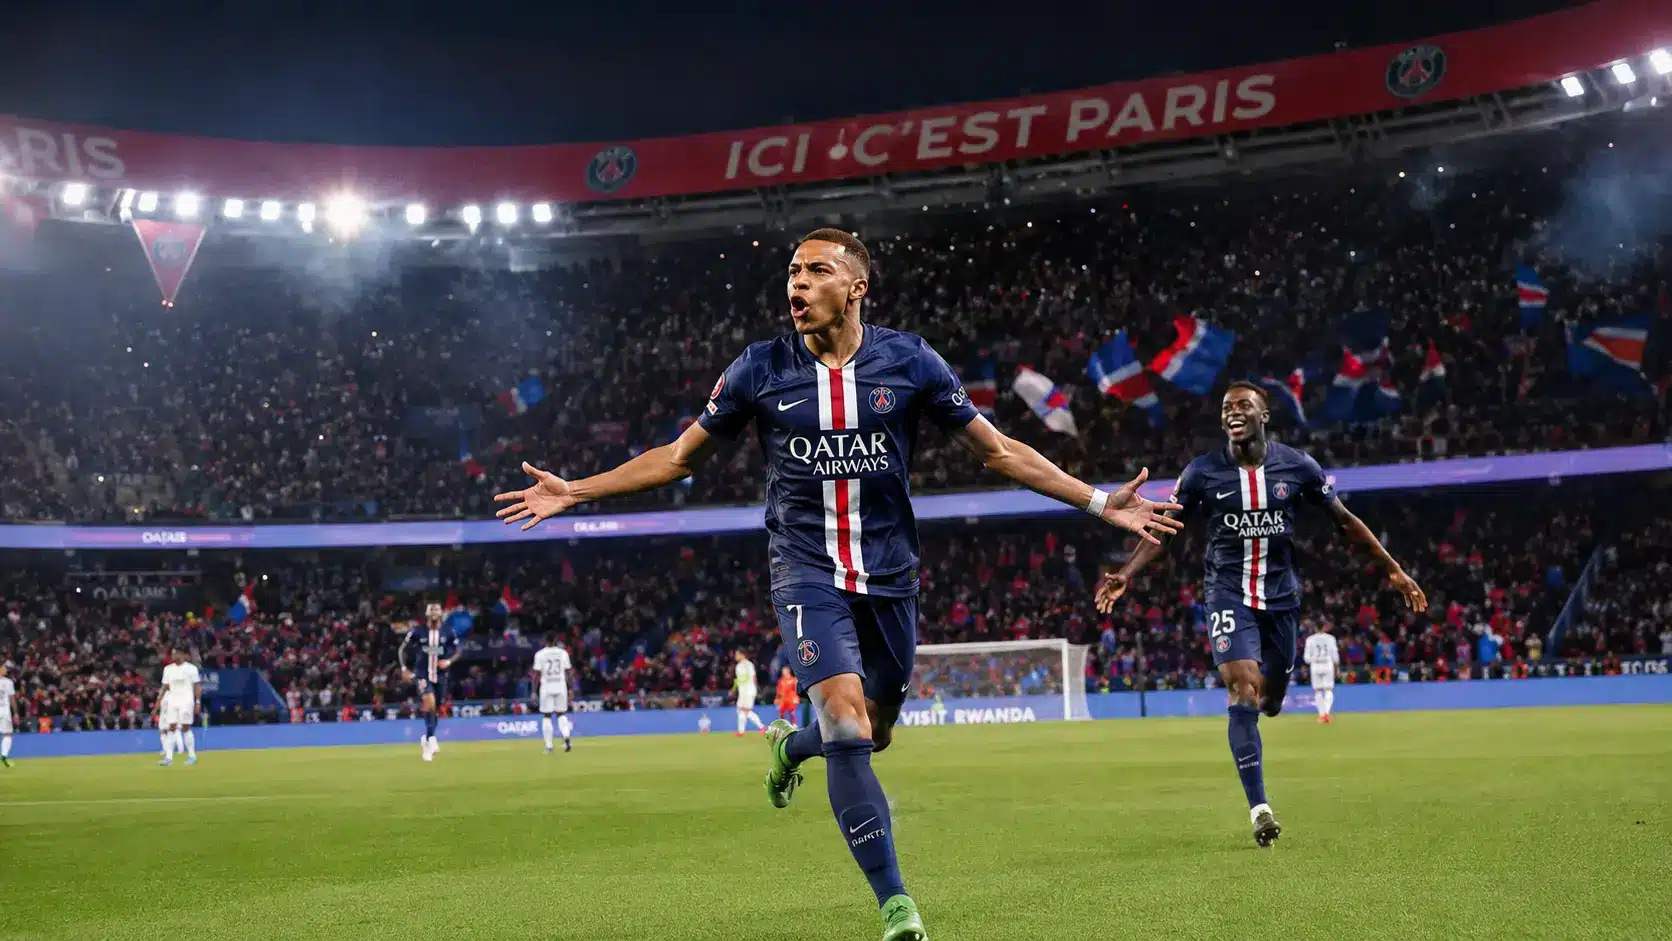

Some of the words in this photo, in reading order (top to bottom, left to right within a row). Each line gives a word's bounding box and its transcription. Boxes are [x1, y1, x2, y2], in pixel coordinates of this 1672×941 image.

[724, 133, 811, 180] ICI
[852, 104, 1048, 167] C'EST
[1065, 74, 1277, 142] PARIS
[789, 432, 888, 464] QATAR
[813, 455, 889, 475] AIRWAYS
[1224, 510, 1284, 530] QATAR
[1238, 523, 1285, 537] AIRWAYS
[786, 604, 805, 639] 7
[1211, 610, 1236, 637] 25
[901, 709, 947, 726] VISIT
[955, 707, 1036, 724] RWANDA
